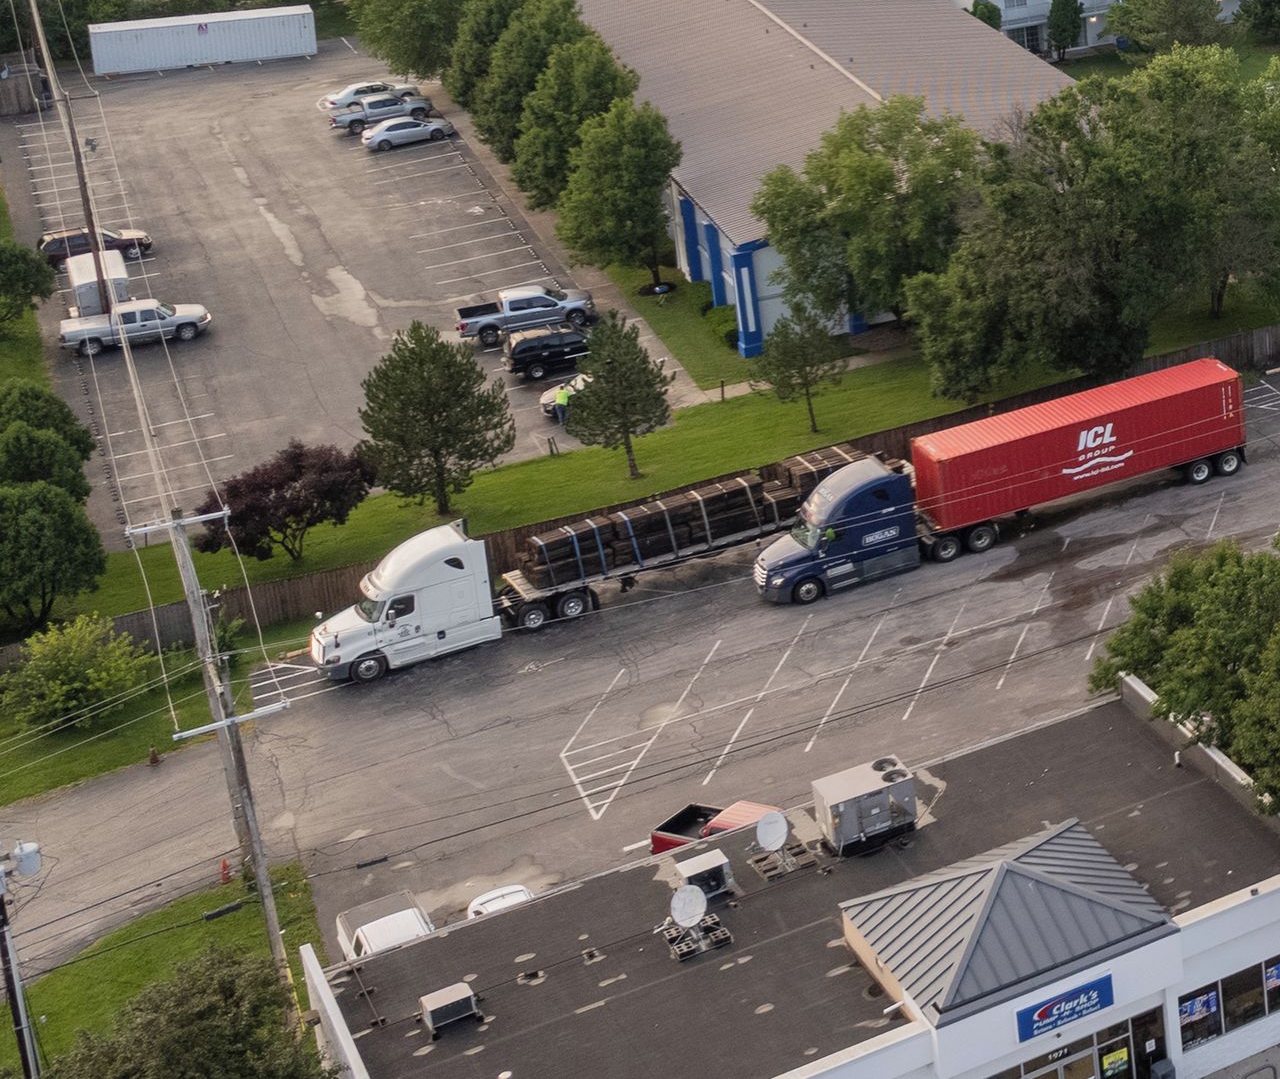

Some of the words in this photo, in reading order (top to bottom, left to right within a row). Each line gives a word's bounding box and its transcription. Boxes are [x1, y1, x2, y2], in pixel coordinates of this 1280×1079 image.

[1077, 423, 1117, 452] ICL
[1078, 445, 1116, 461] GROUP
[1033, 1015, 1059, 1030] PUMP
[1075, 998, 1100, 1013] SHOP
[1052, 990, 1098, 1015] Clark's
[1048, 1047, 1069, 1061] 1971
